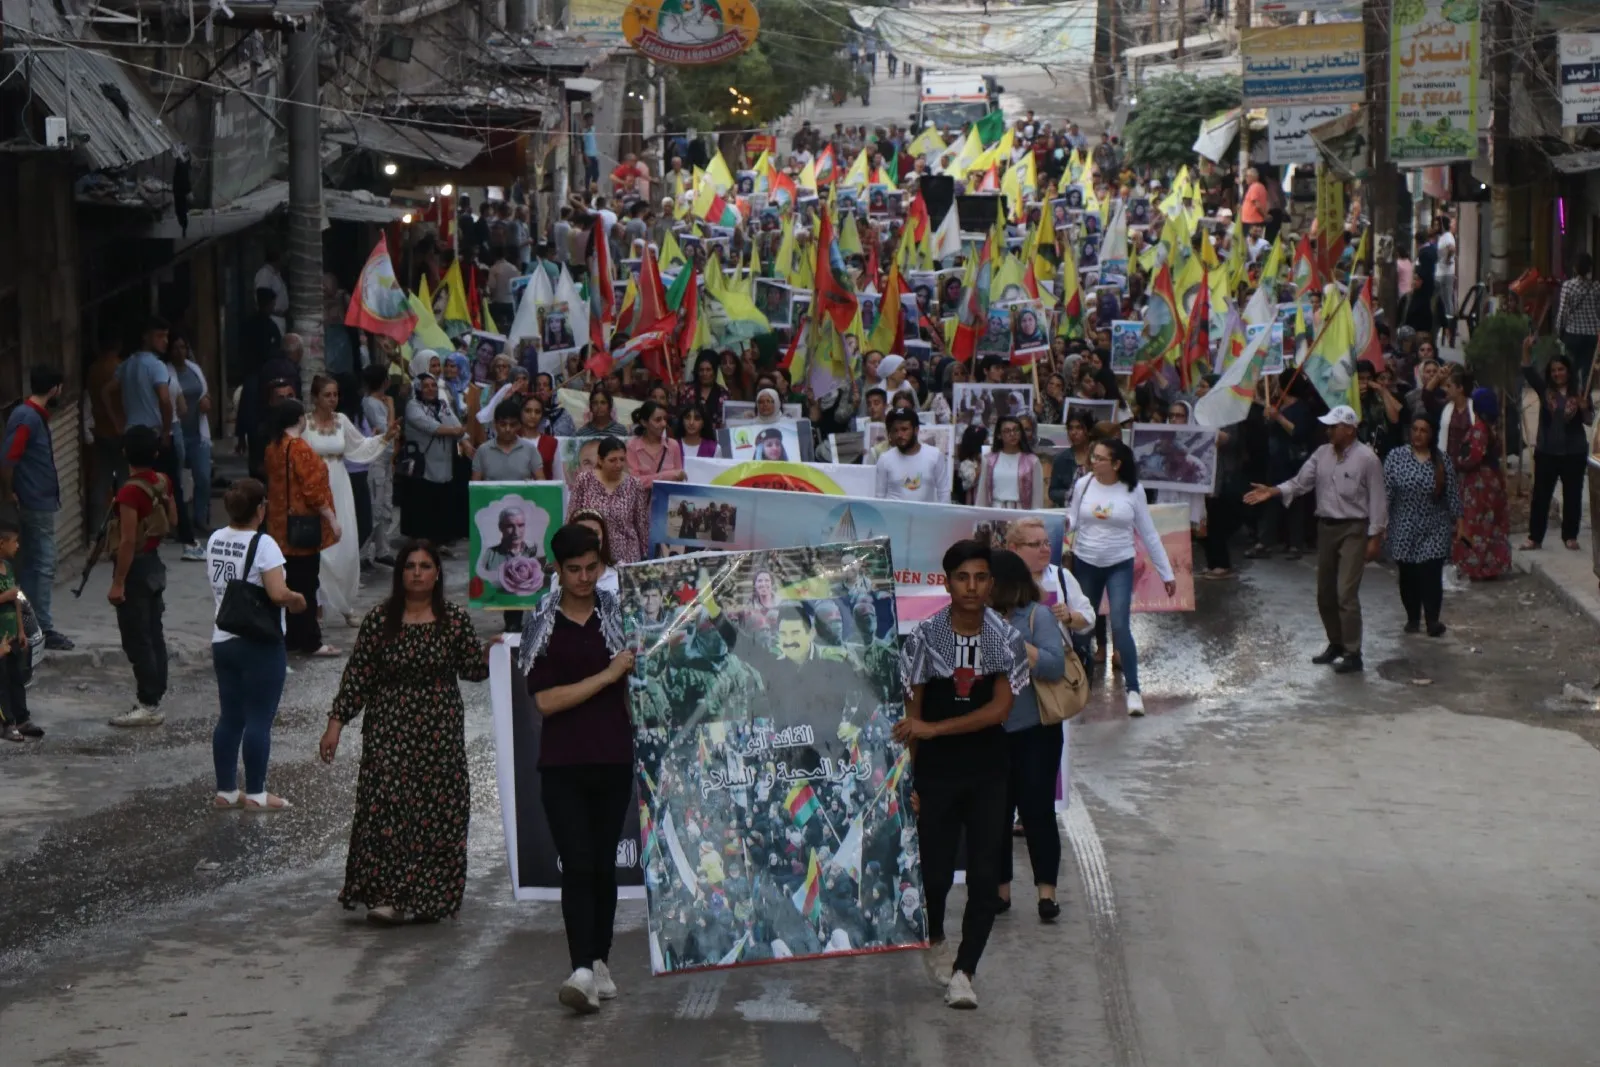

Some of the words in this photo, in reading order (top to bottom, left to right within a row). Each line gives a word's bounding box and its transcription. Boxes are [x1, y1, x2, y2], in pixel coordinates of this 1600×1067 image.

[1400, 40, 1470, 67] الشلال
[1246, 56, 1297, 76] الطبية
[1401, 92, 1416, 106] EL
[1300, 106, 1343, 122] المحامي
[213, 560, 236, 582] 78
[772, 724, 815, 748] القائد
[763, 771, 775, 789] و
[776, 756, 834, 787] المحبة
[834, 758, 872, 781] رمز
[701, 766, 755, 799] السلام
